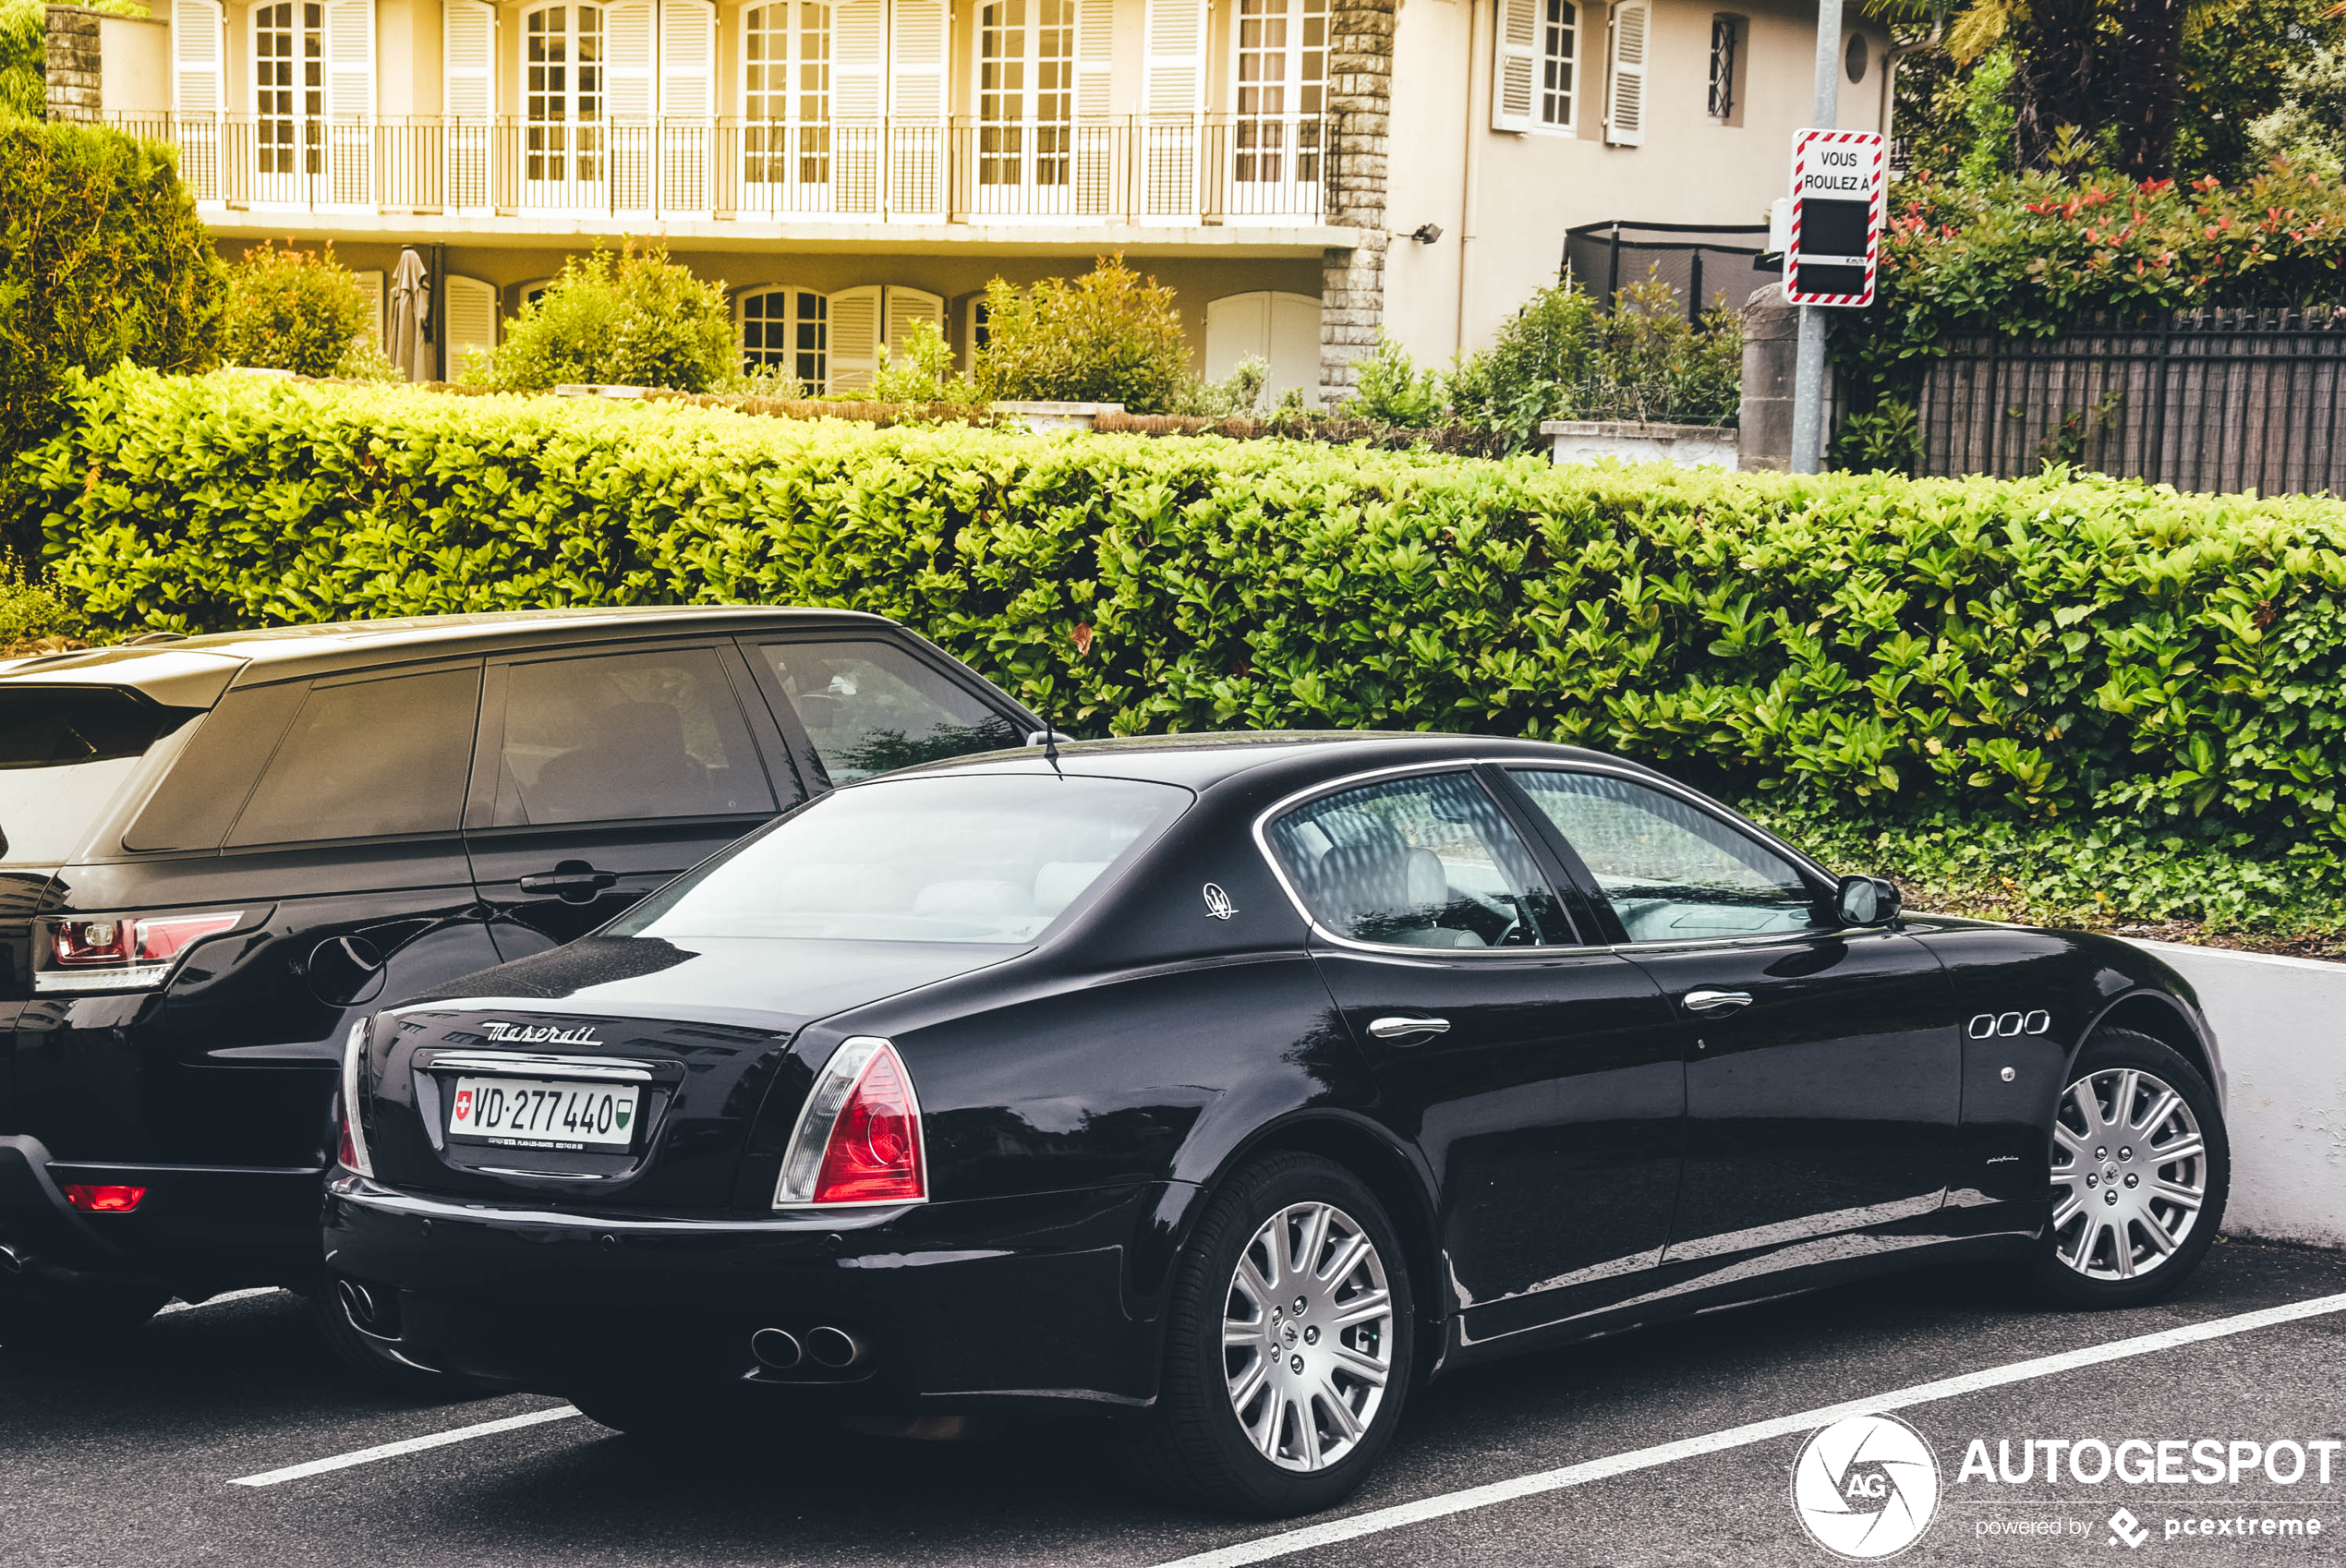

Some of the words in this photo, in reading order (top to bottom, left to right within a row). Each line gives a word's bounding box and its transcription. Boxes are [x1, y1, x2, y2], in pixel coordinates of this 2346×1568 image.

[1821, 151, 1857, 167] VOUS
[1805, 175, 1857, 190] ROULEZ
[1861, 173, 1870, 191] À
[482, 1022, 603, 1046] Maserati
